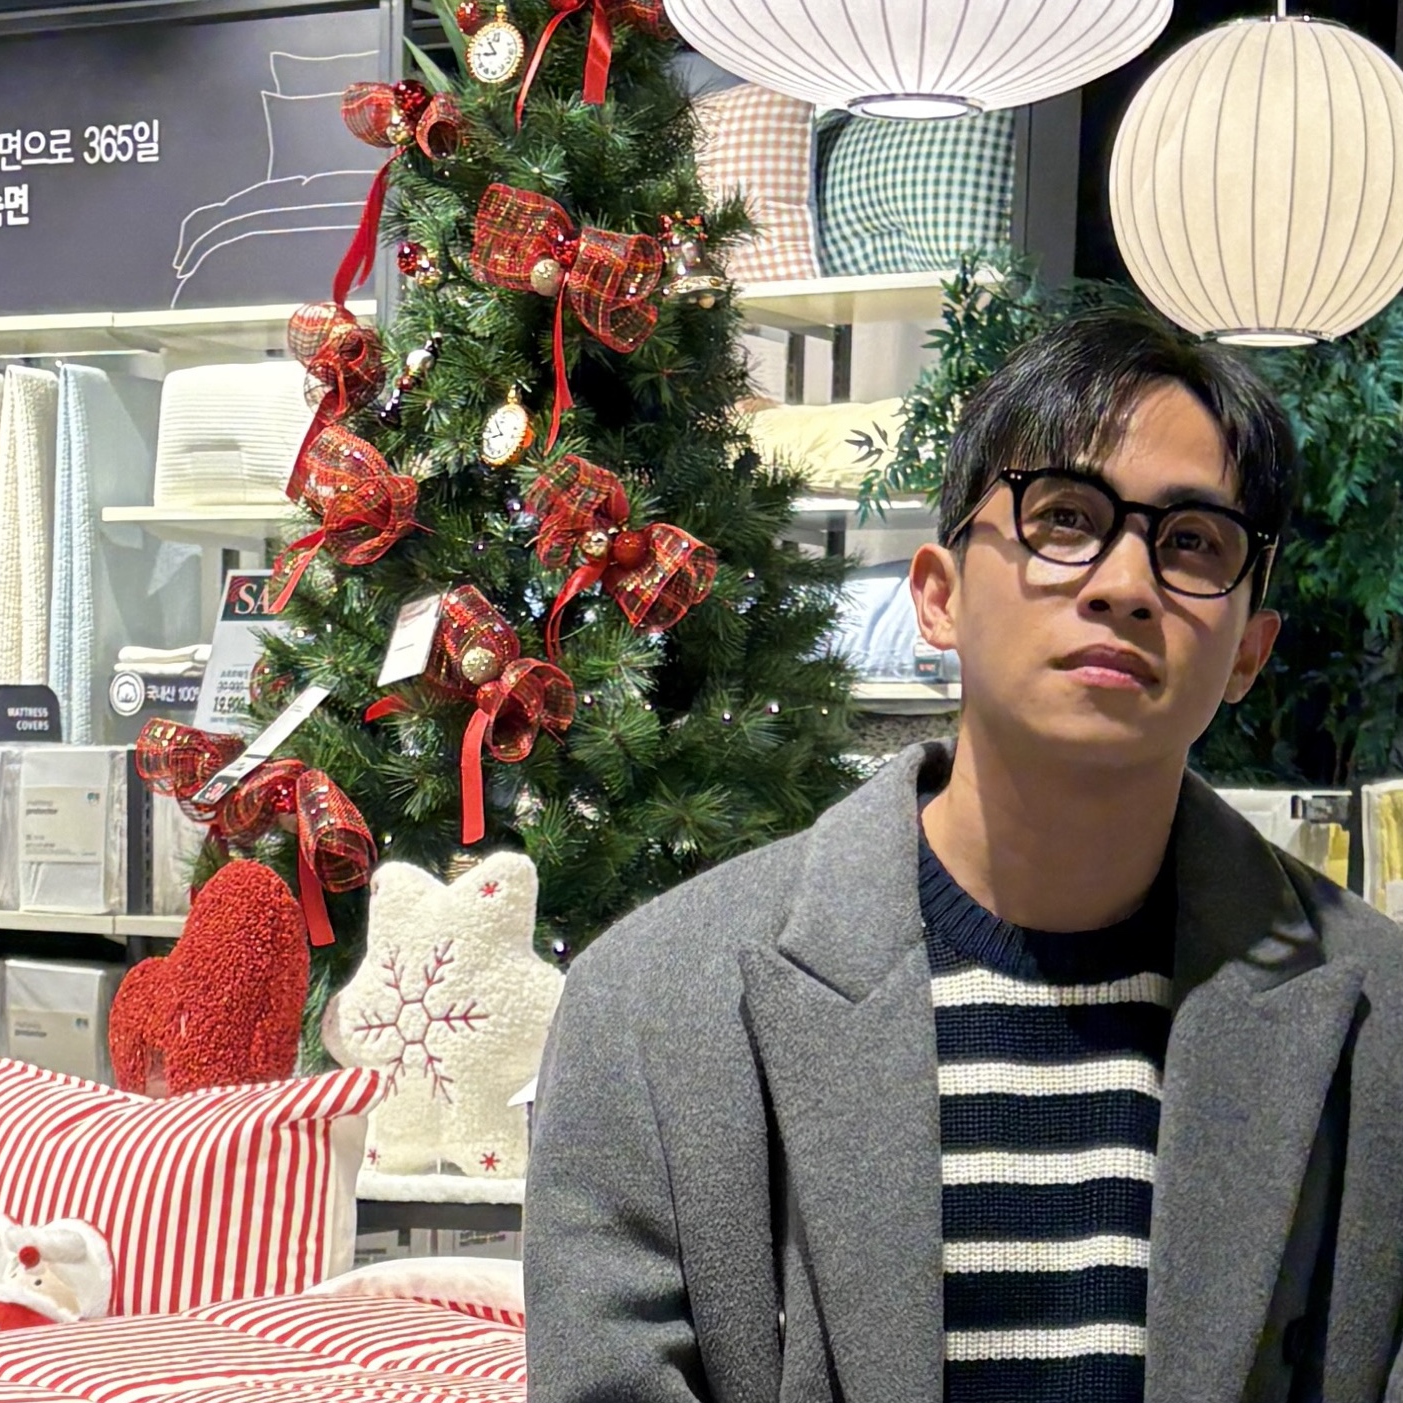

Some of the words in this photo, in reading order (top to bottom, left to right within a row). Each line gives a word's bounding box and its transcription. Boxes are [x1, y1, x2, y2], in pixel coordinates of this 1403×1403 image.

[83, 119, 160, 165] 365일
[234, 582, 269, 615] SA
[7, 707, 50, 718] MATTRESS
[16, 720, 50, 731] COVERS
